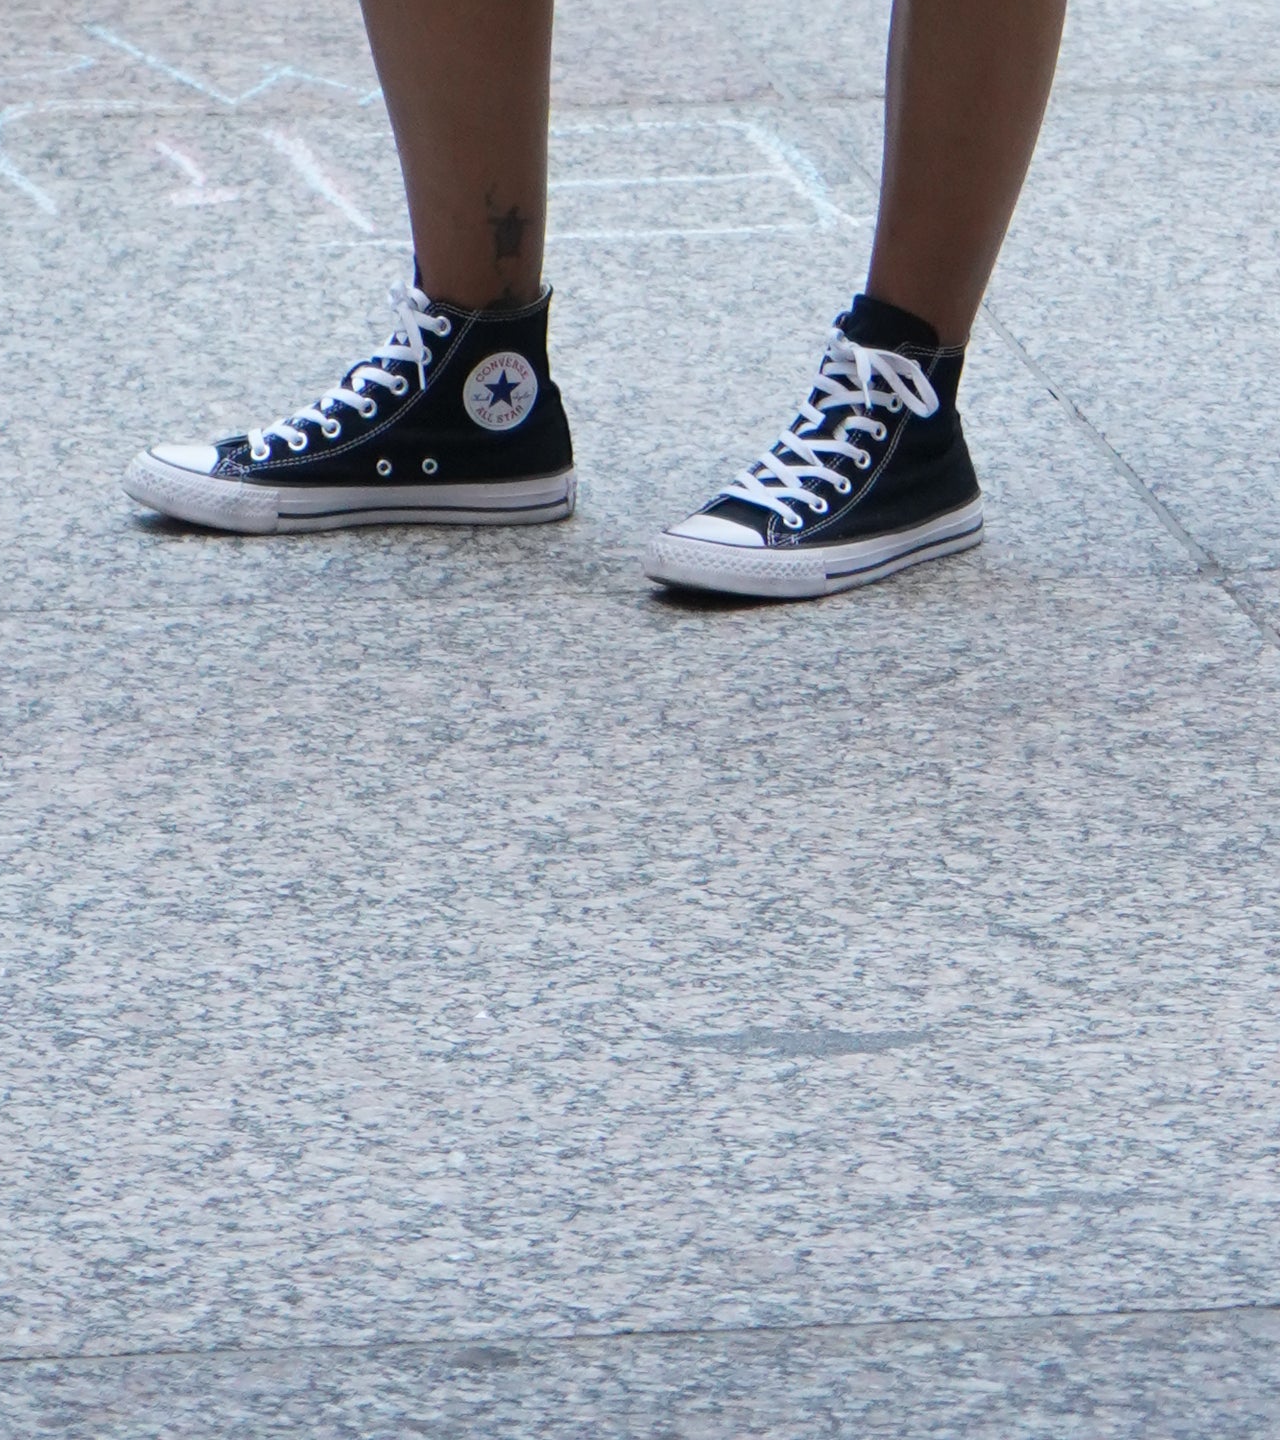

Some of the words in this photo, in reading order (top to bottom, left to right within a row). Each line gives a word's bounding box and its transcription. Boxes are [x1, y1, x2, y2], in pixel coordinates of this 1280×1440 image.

[475, 355, 529, 383] CONVERSE
[476, 407, 493, 423] ALL
[496, 404, 524, 424] STAR
